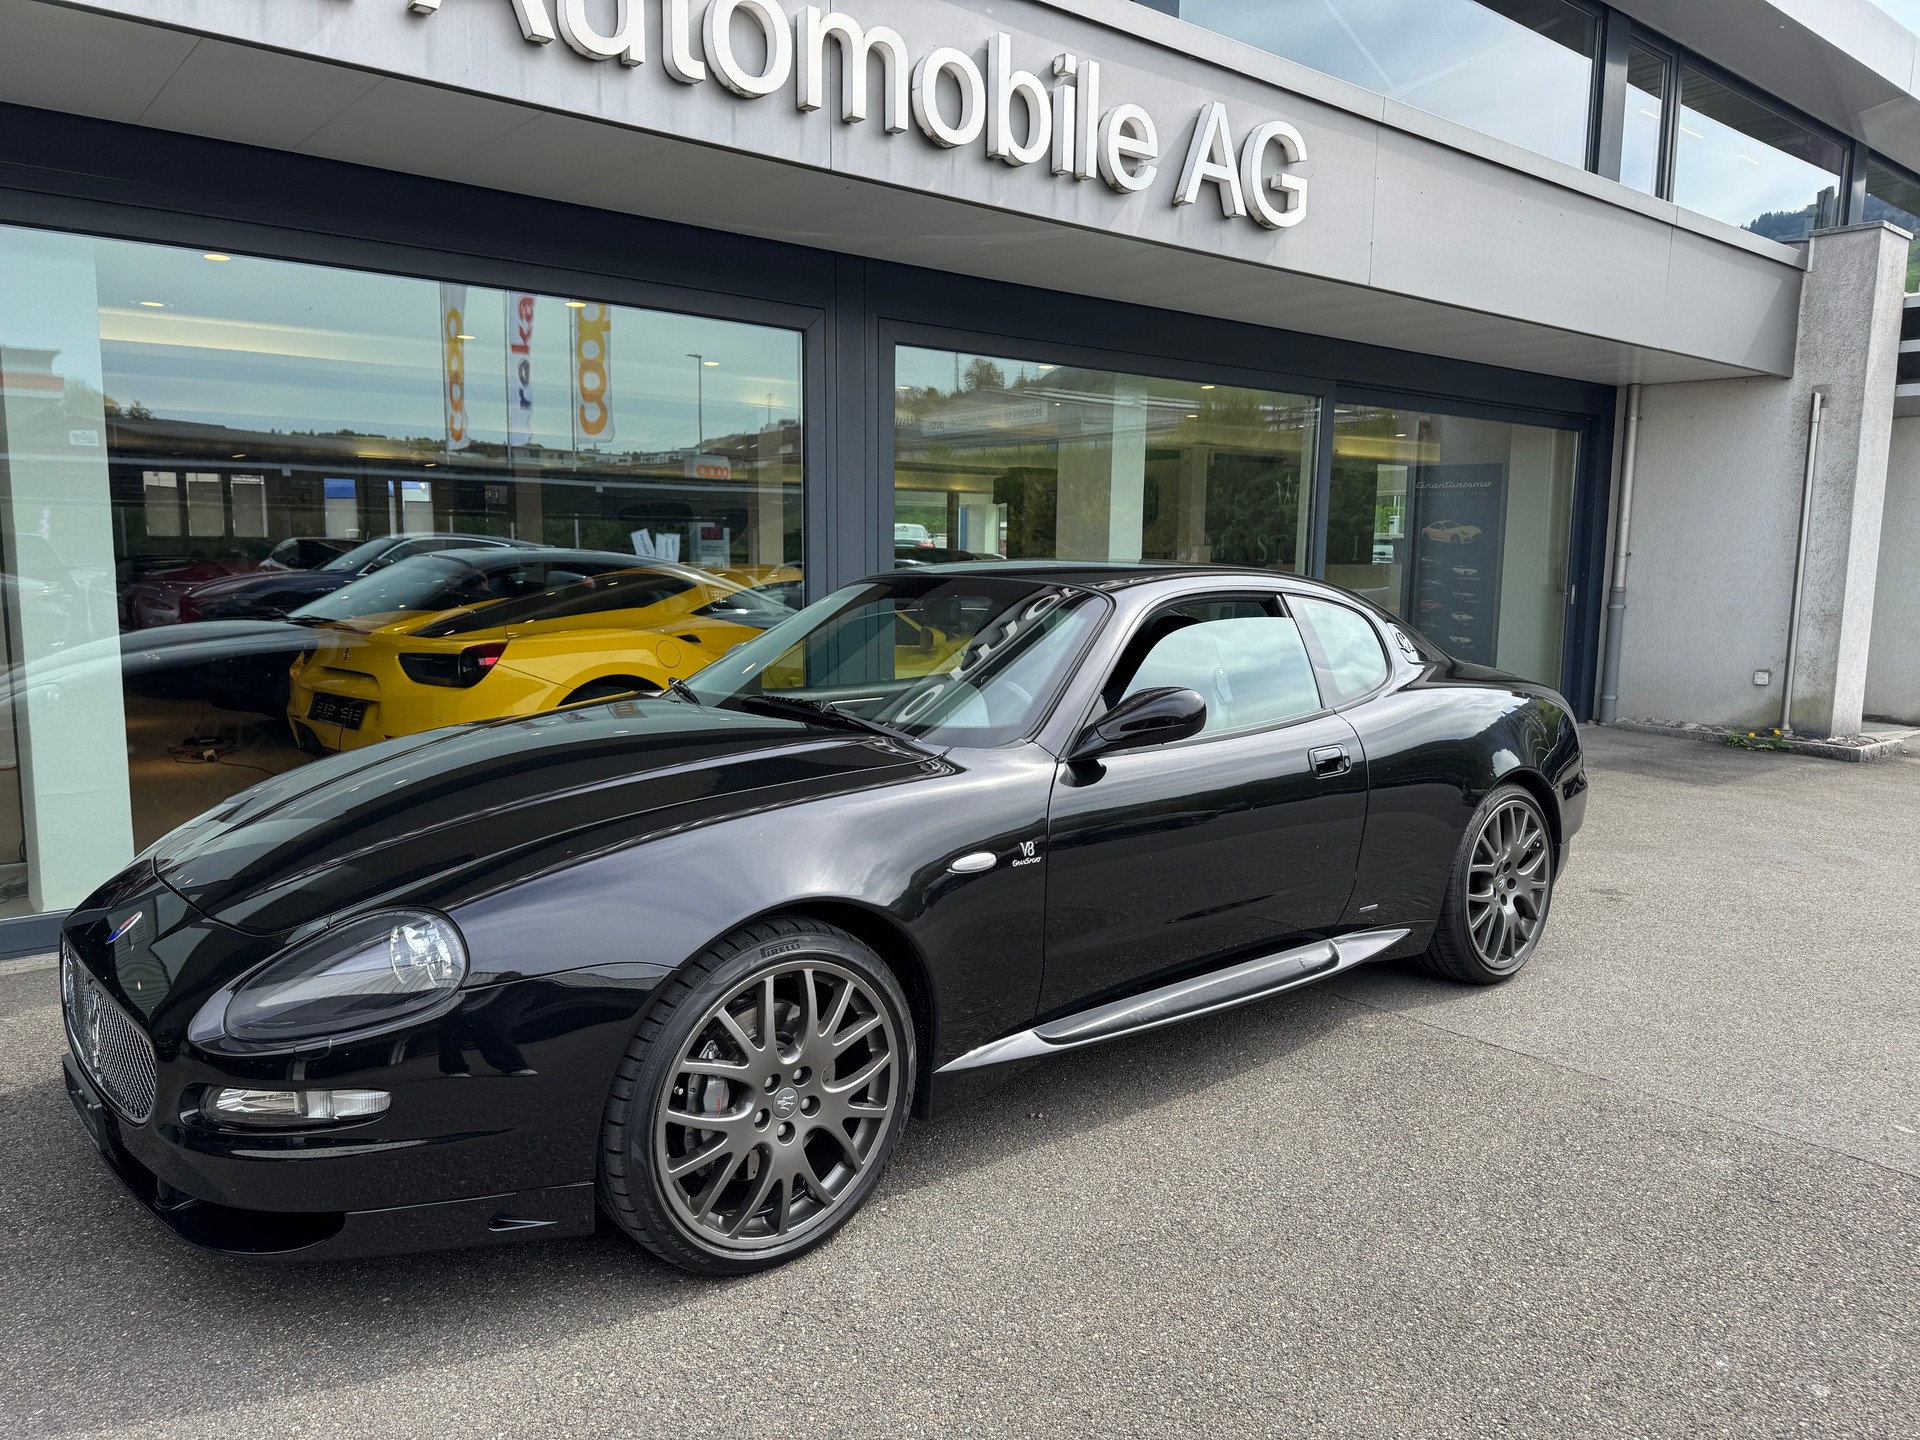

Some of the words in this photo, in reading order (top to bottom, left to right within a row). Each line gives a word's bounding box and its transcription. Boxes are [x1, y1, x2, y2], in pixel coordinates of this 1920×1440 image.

[408, 0, 1158, 194] utomobile
[1172, 100, 1309, 231] AG
[446, 307, 464, 442] coop
[511, 297, 535, 411] reka
[577, 303, 611, 436] coop
[1019, 841, 1035, 857] V8
[759, 938, 801, 959] PIRELLI
[644, 1199, 668, 1231] ZR19
[664, 1234, 710, 1264] 235/35
